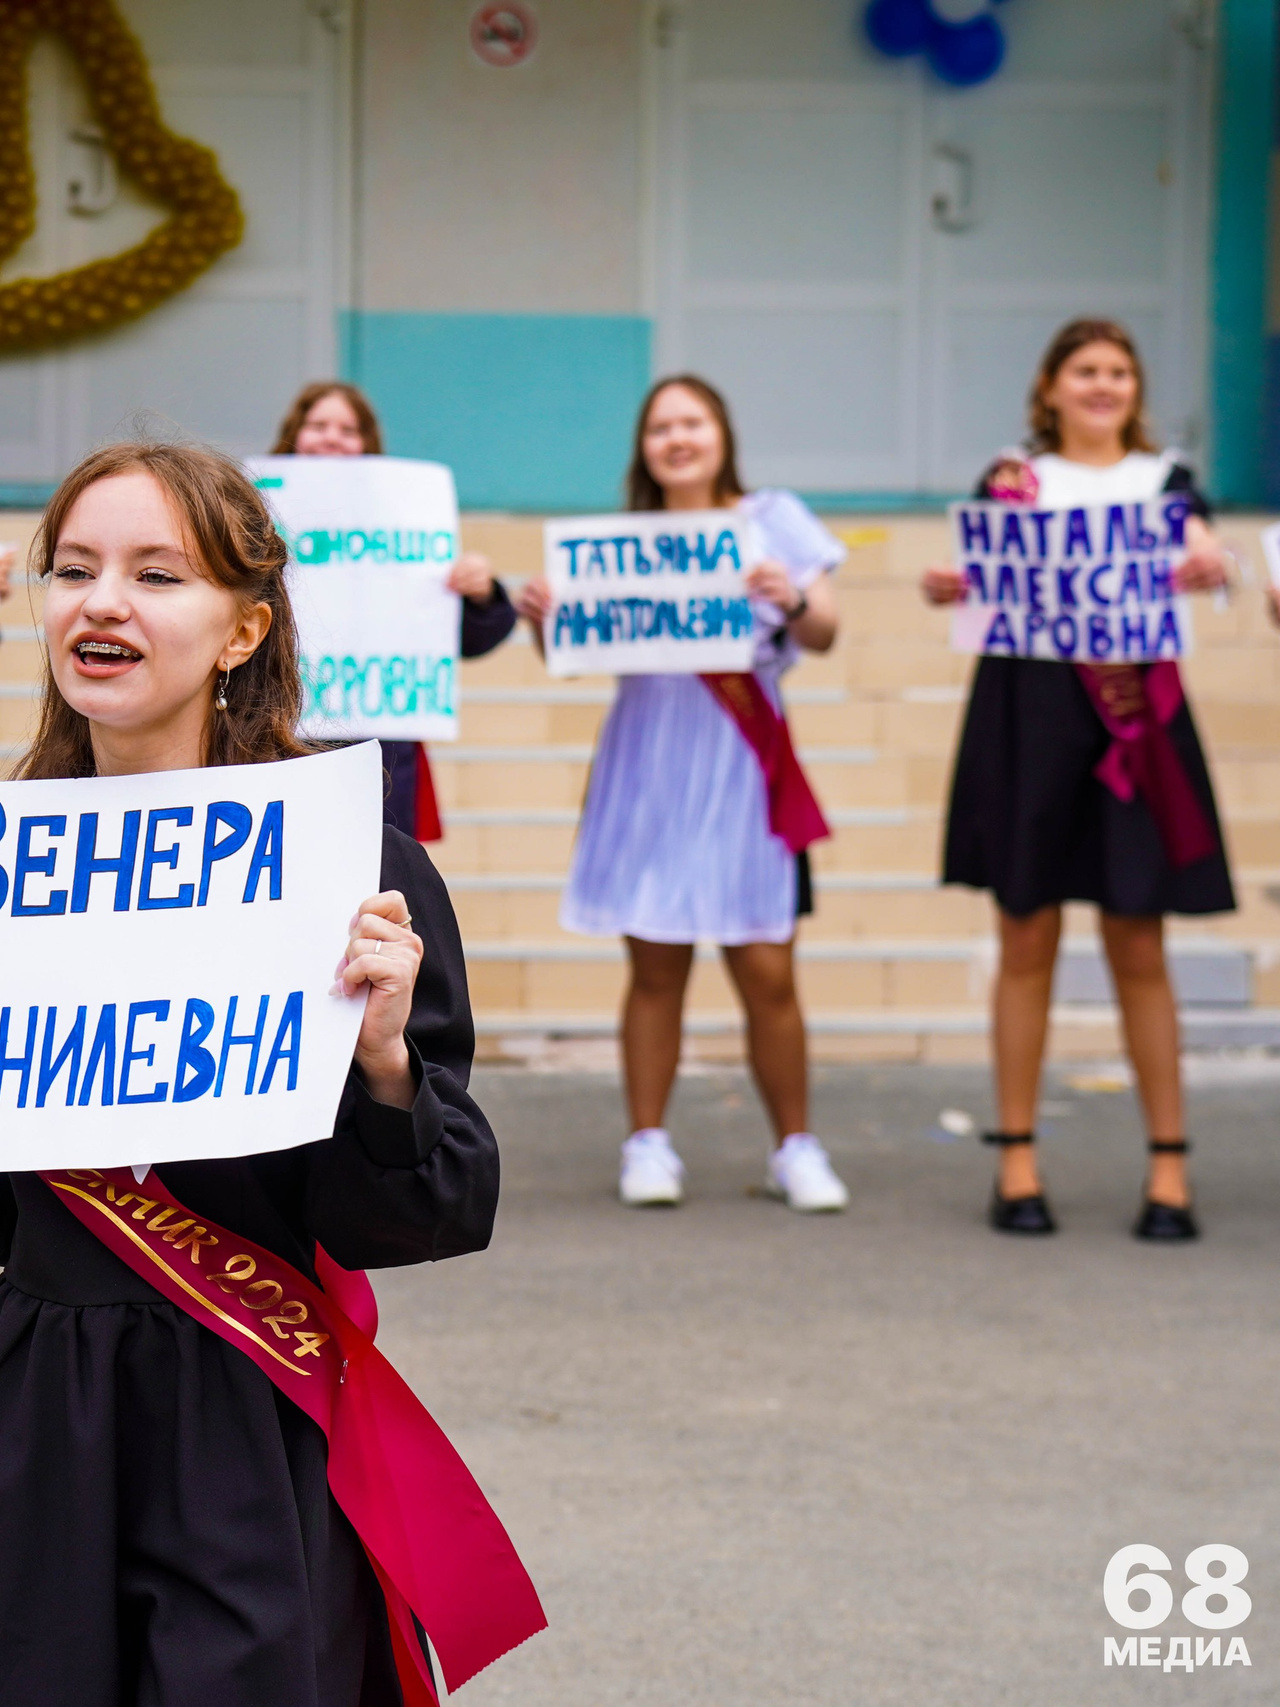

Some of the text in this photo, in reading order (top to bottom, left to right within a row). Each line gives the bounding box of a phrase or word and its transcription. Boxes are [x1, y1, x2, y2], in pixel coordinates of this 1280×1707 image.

[559, 530, 741, 577] ТАТЬЯНА
[960, 502, 1190, 558] НАТАЛЬЯ
[206, 1253, 330, 1357] 2024
